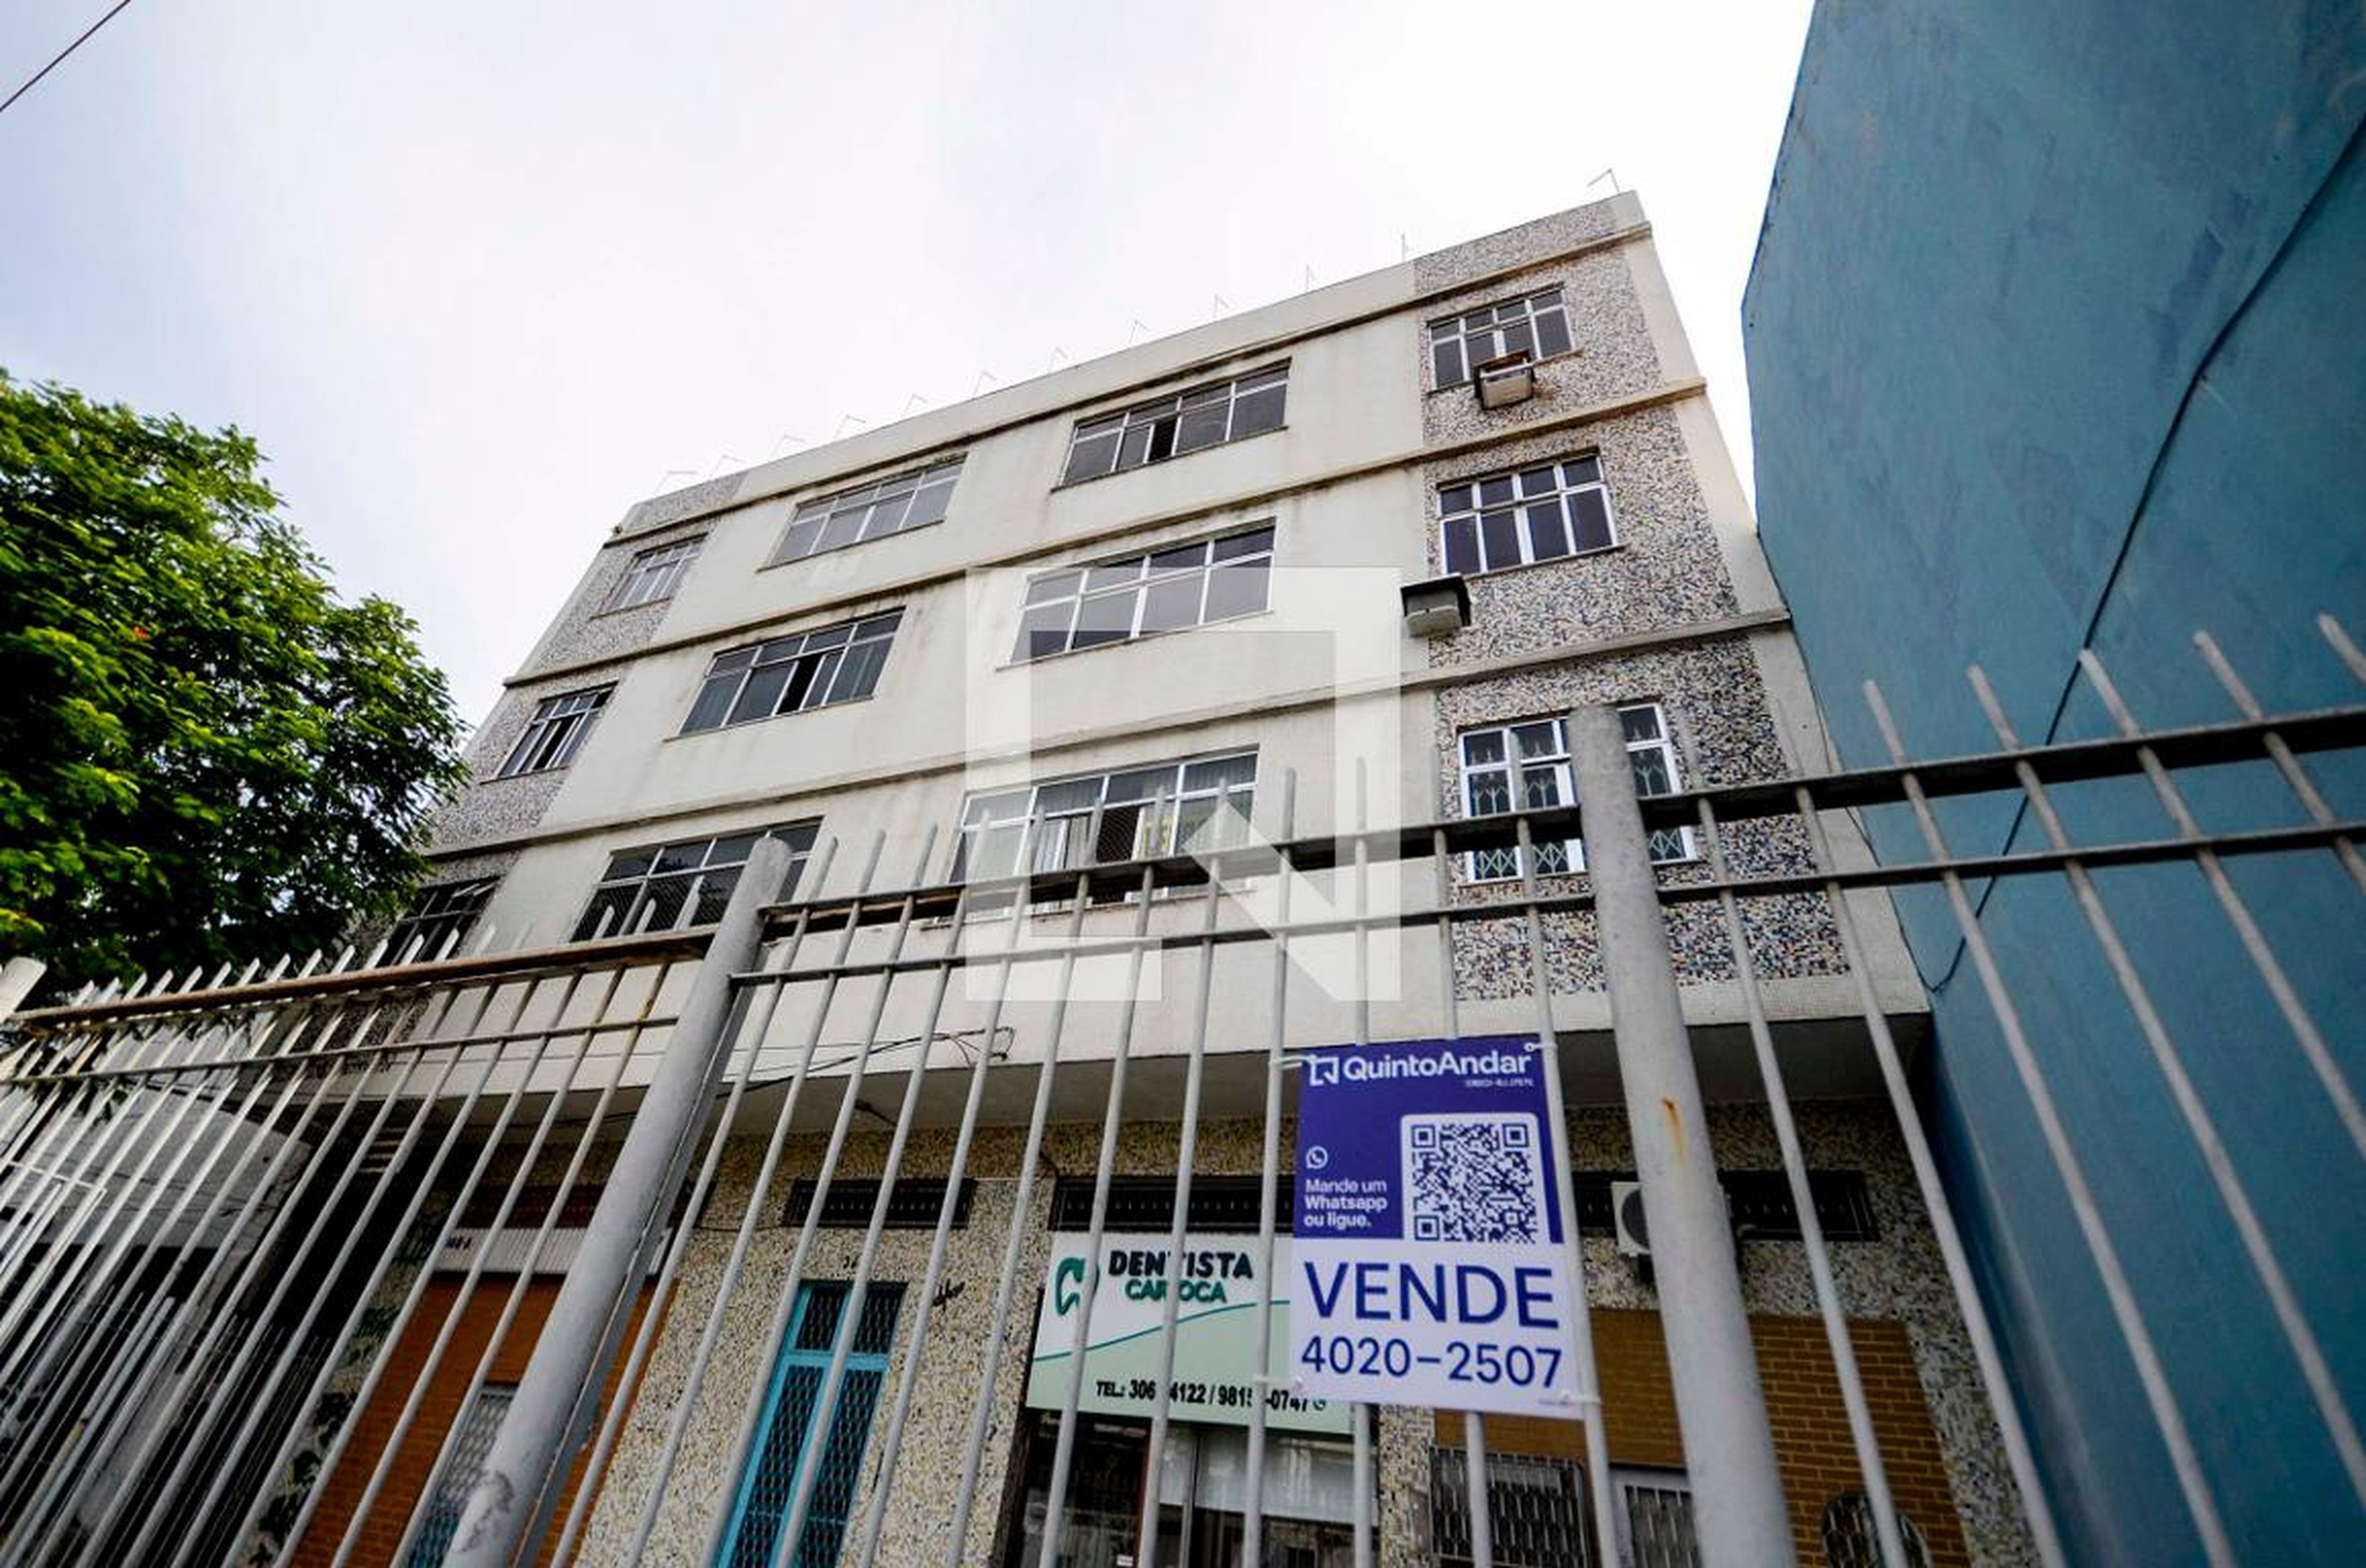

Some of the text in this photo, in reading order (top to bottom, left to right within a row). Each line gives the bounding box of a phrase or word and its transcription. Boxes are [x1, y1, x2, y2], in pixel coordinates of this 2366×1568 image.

[1344, 1050, 1531, 1081] QuintoAndar
[1306, 1178, 1387, 1193] Mande um
[1304, 1195, 1388, 1213] Whatsapp
[1304, 1211, 1372, 1230] ou ligue.
[1108, 1250, 1253, 1280] DENISTA
[1125, 1278, 1227, 1304] CAROCA
[1304, 1261, 1559, 1329] VENDE
[1302, 1336, 1561, 1388] 4020-2507
